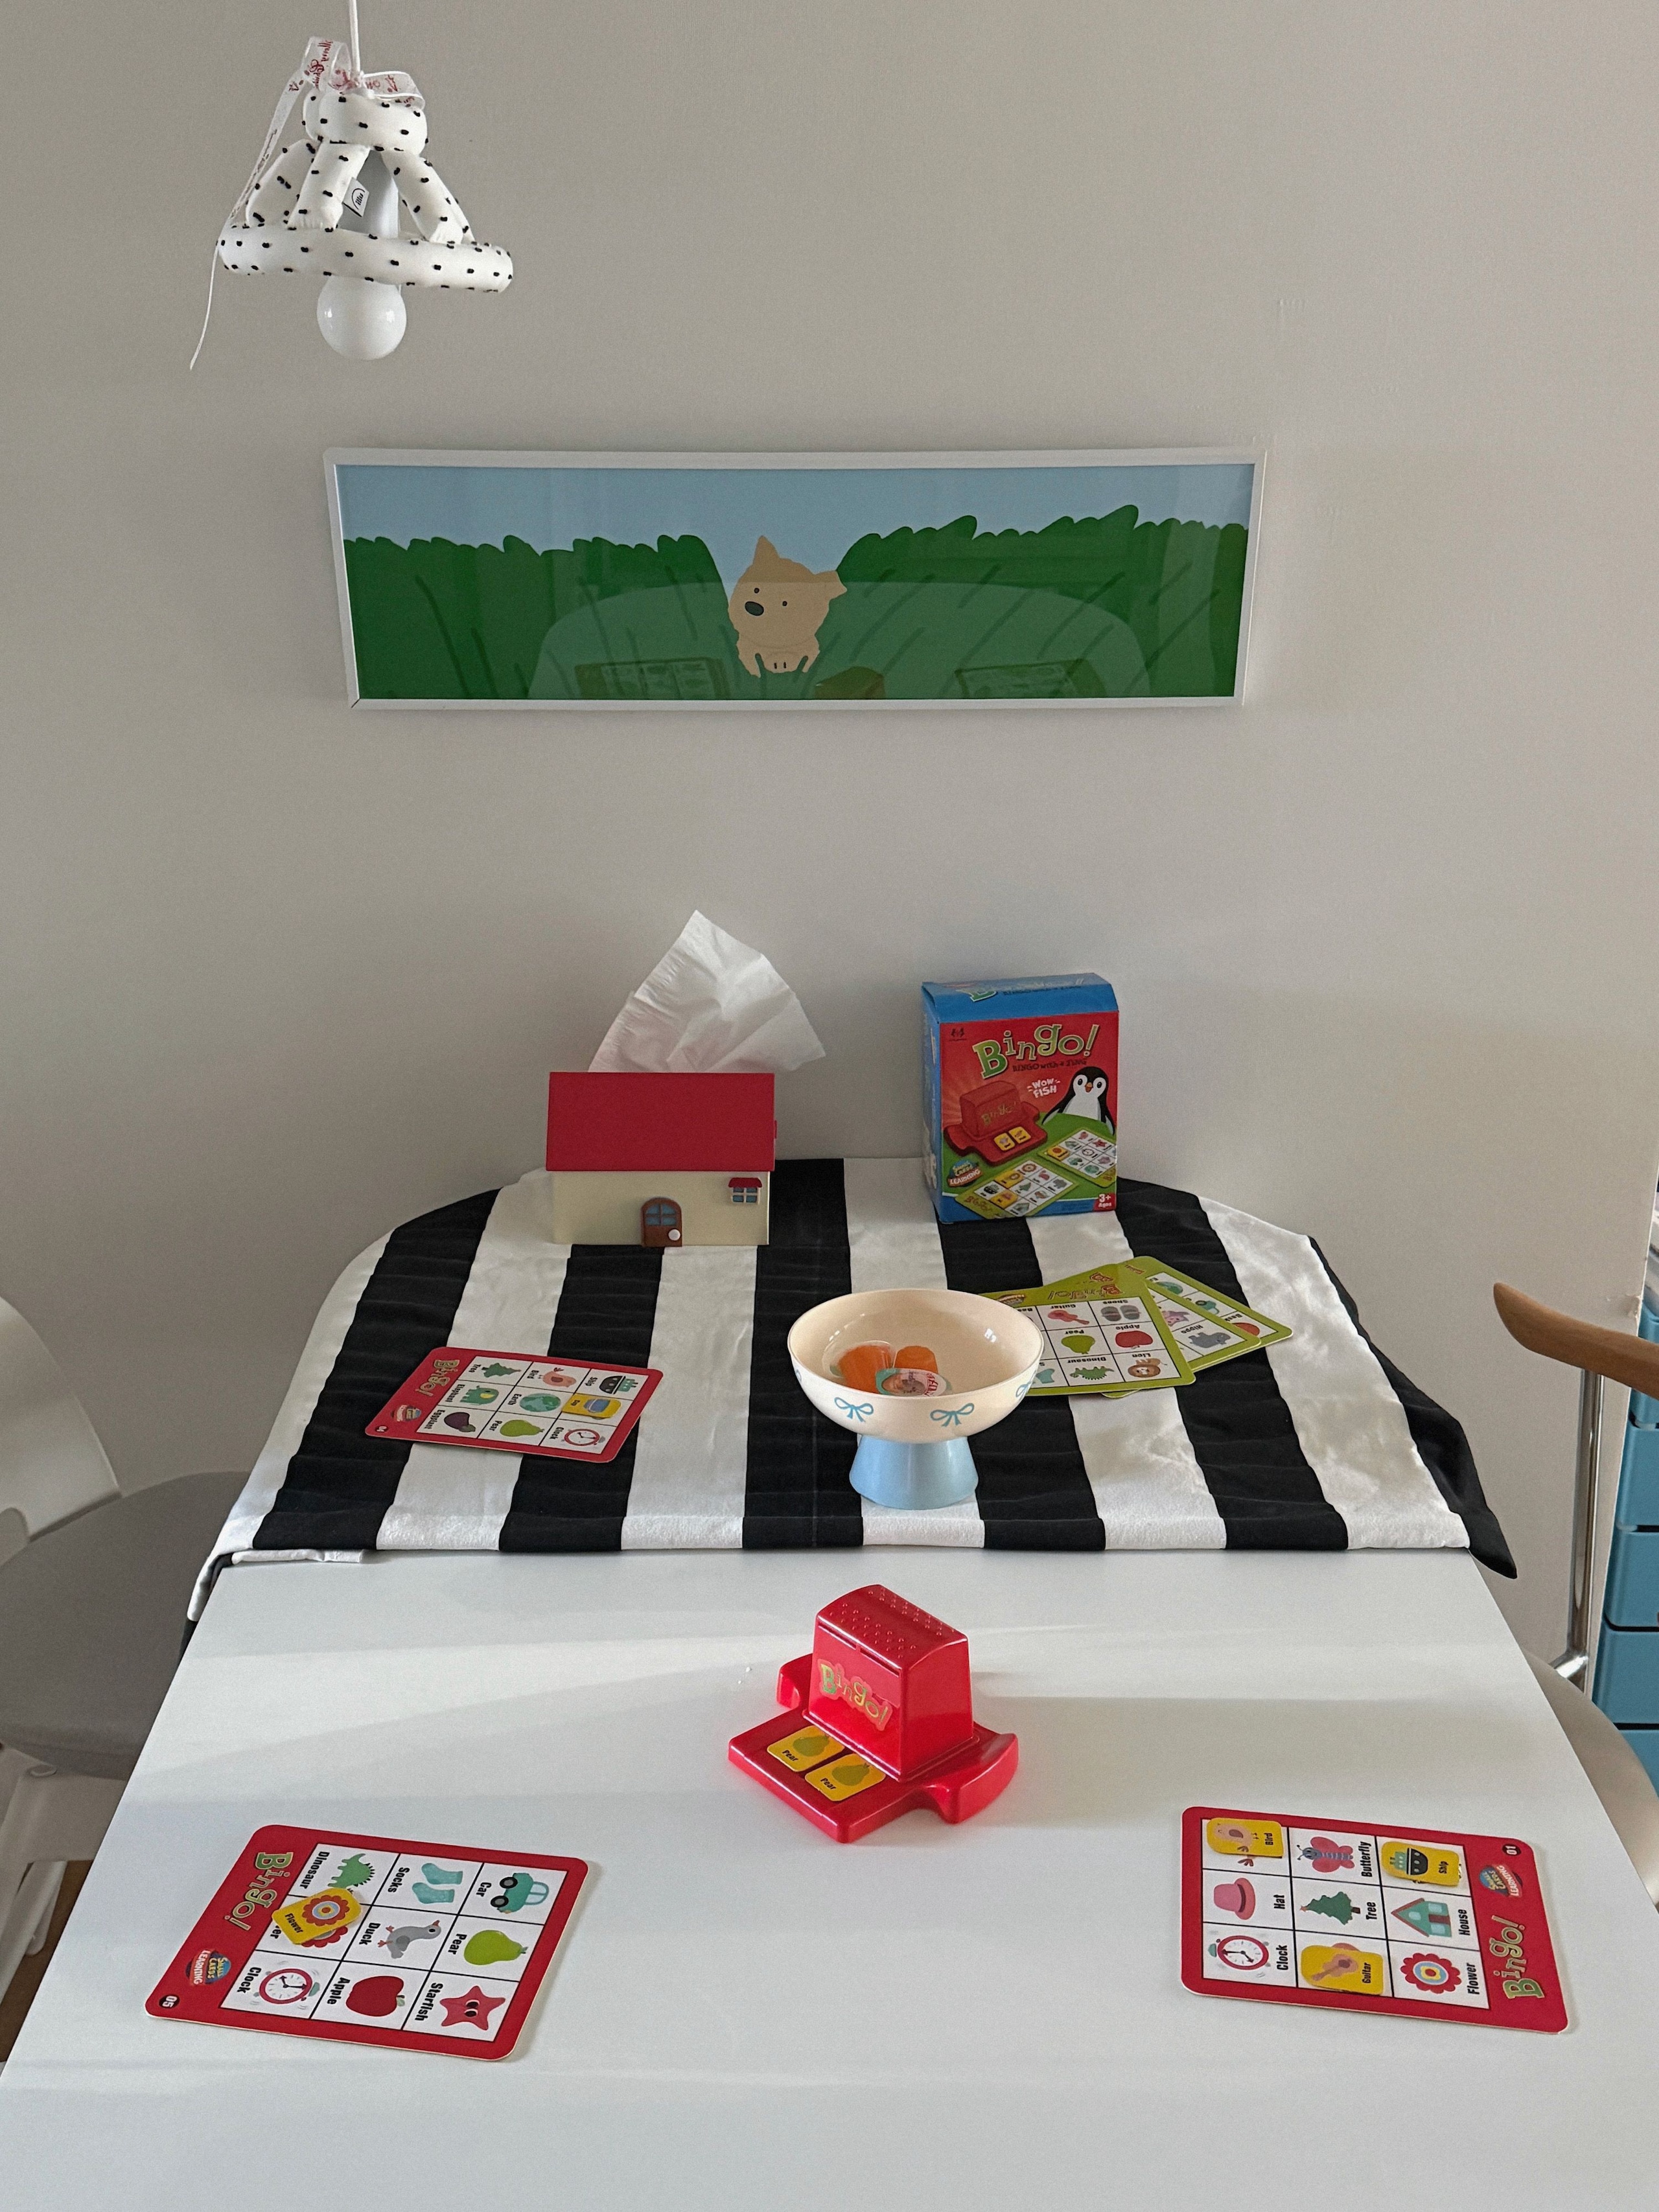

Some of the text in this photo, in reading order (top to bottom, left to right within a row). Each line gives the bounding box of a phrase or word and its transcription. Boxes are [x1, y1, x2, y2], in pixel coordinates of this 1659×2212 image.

[973, 1024, 1099, 1079] Bingo!
[1033, 1085, 1057, 1098] FISH
[950, 1168, 980, 1184] LEARNING
[1098, 1193, 1111, 1203] 3+
[1181, 1324, 1203, 1333] Hippo
[415, 1359, 460, 1397] Bingo!
[469, 1364, 481, 1373] Tree
[527, 1370, 539, 1379] Bird
[585, 1377, 598, 1387] Ship
[445, 1384, 465, 1403] Elephant
[507, 1394, 522, 1405] Earth
[424, 1410, 445, 1429] Eggplant
[489, 1420, 503, 1431] Pear
[550, 1427, 564, 1440] Clock
[820, 1664, 888, 1725] Bingo!
[782, 1750, 798, 1761] Pear
[820, 1778, 837, 1790] Pear
[1264, 1832, 1273, 1845] Bird
[1358, 1841, 1373, 1877] Butterfly
[1505, 1845, 1517, 1855] 01
[299, 1851, 330, 1889] Dinosaur
[1438, 1861, 1448, 1874] Ship
[388, 1867, 410, 1893] Socks
[476, 1882, 492, 1897] Car
[1496, 1865, 1519, 1896] LEARNING
[224, 1852, 294, 1931] Bingo!
[1273, 1894, 1285, 1909] Hat
[1366, 1902, 1377, 1920] Tree
[284, 1913, 304, 1933] Flower
[1458, 1909, 1470, 1936] House
[359, 1922, 381, 1945] Duck
[448, 1933, 467, 1955] Pear
[1276, 1944, 1288, 1970] Clock
[1489, 1915, 1545, 1999] Bingo!
[194, 1950, 211, 1985] LEARNING
[1362, 1963, 1371, 1984] Guitar
[237, 1967, 262, 1994] Clock
[1467, 1963, 1479, 1995] Flower
[327, 1977, 351, 2005] Apple
[162, 1996, 178, 2008] 05
[415, 1983, 444, 2022] Starfish
